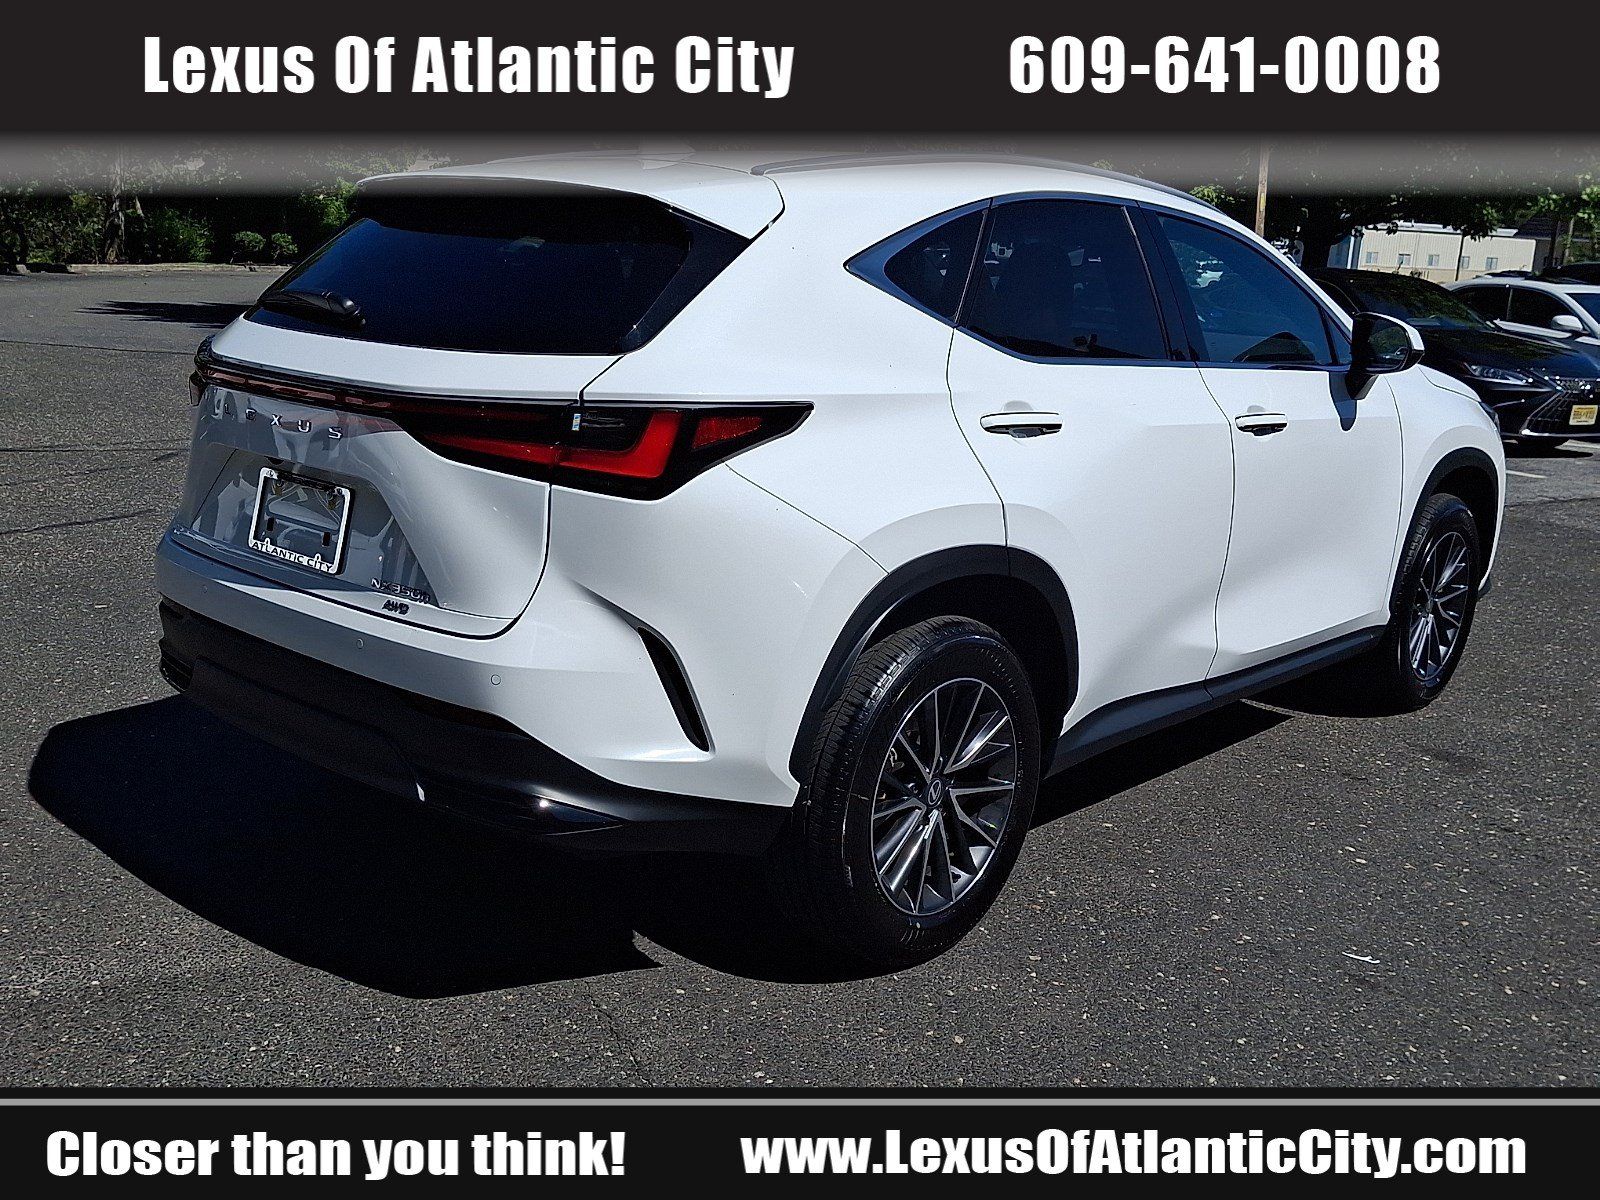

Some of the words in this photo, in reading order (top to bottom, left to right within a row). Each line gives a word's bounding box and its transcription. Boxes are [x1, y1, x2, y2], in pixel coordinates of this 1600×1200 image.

[251, 541, 305, 565] ATLANTIC
[306, 558, 333, 571] CITY
[382, 599, 410, 615] AWD
